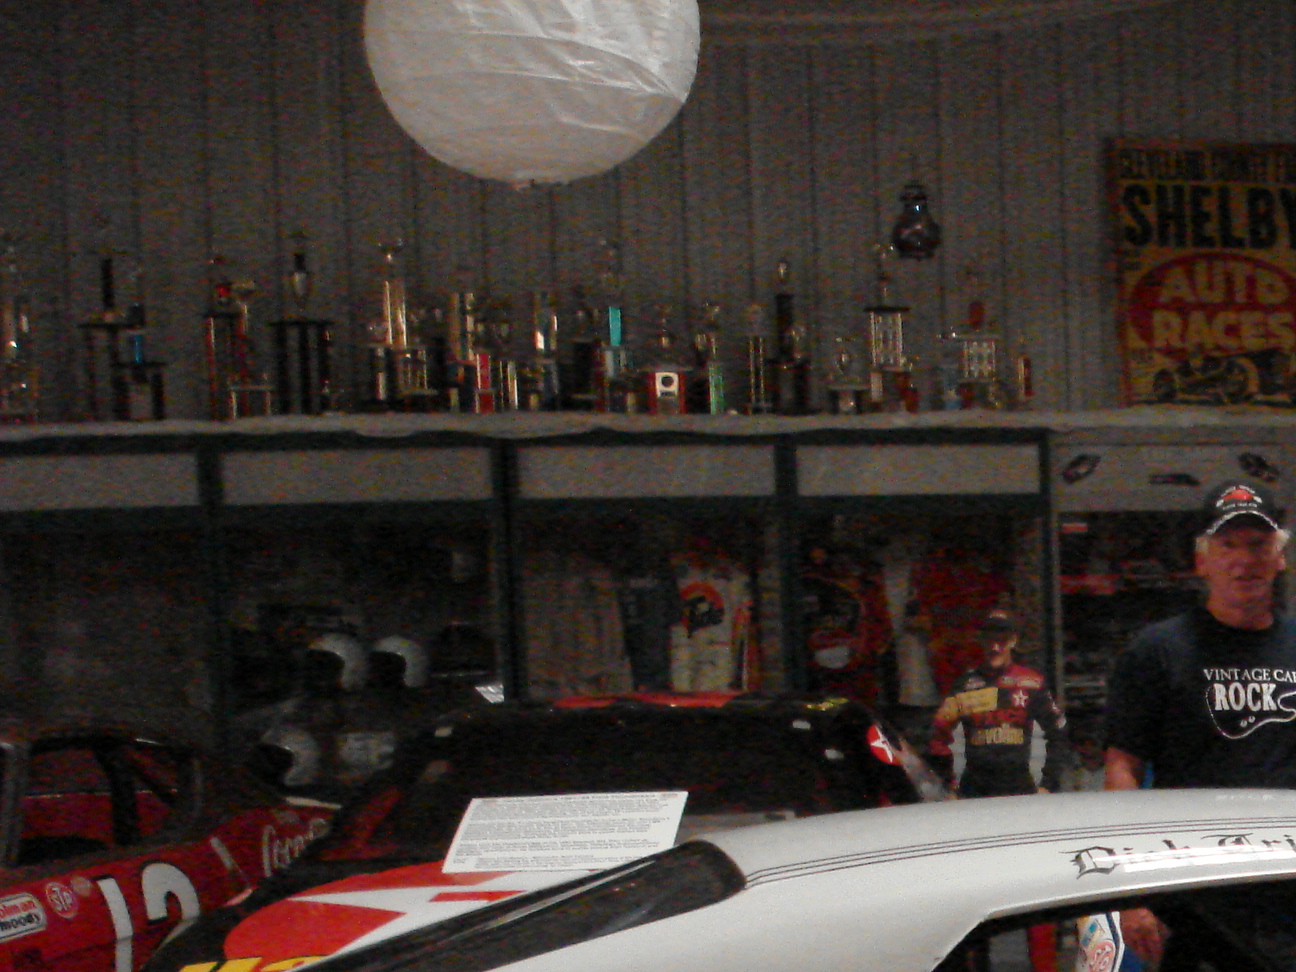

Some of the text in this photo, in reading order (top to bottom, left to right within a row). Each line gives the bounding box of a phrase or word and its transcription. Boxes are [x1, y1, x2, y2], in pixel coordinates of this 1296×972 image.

[1159, 262, 1290, 304] AUTO
[1152, 308, 1296, 353] RACES
[1203, 667, 1271, 683] VINTAGE
[1213, 682, 1277, 712] ROCK
